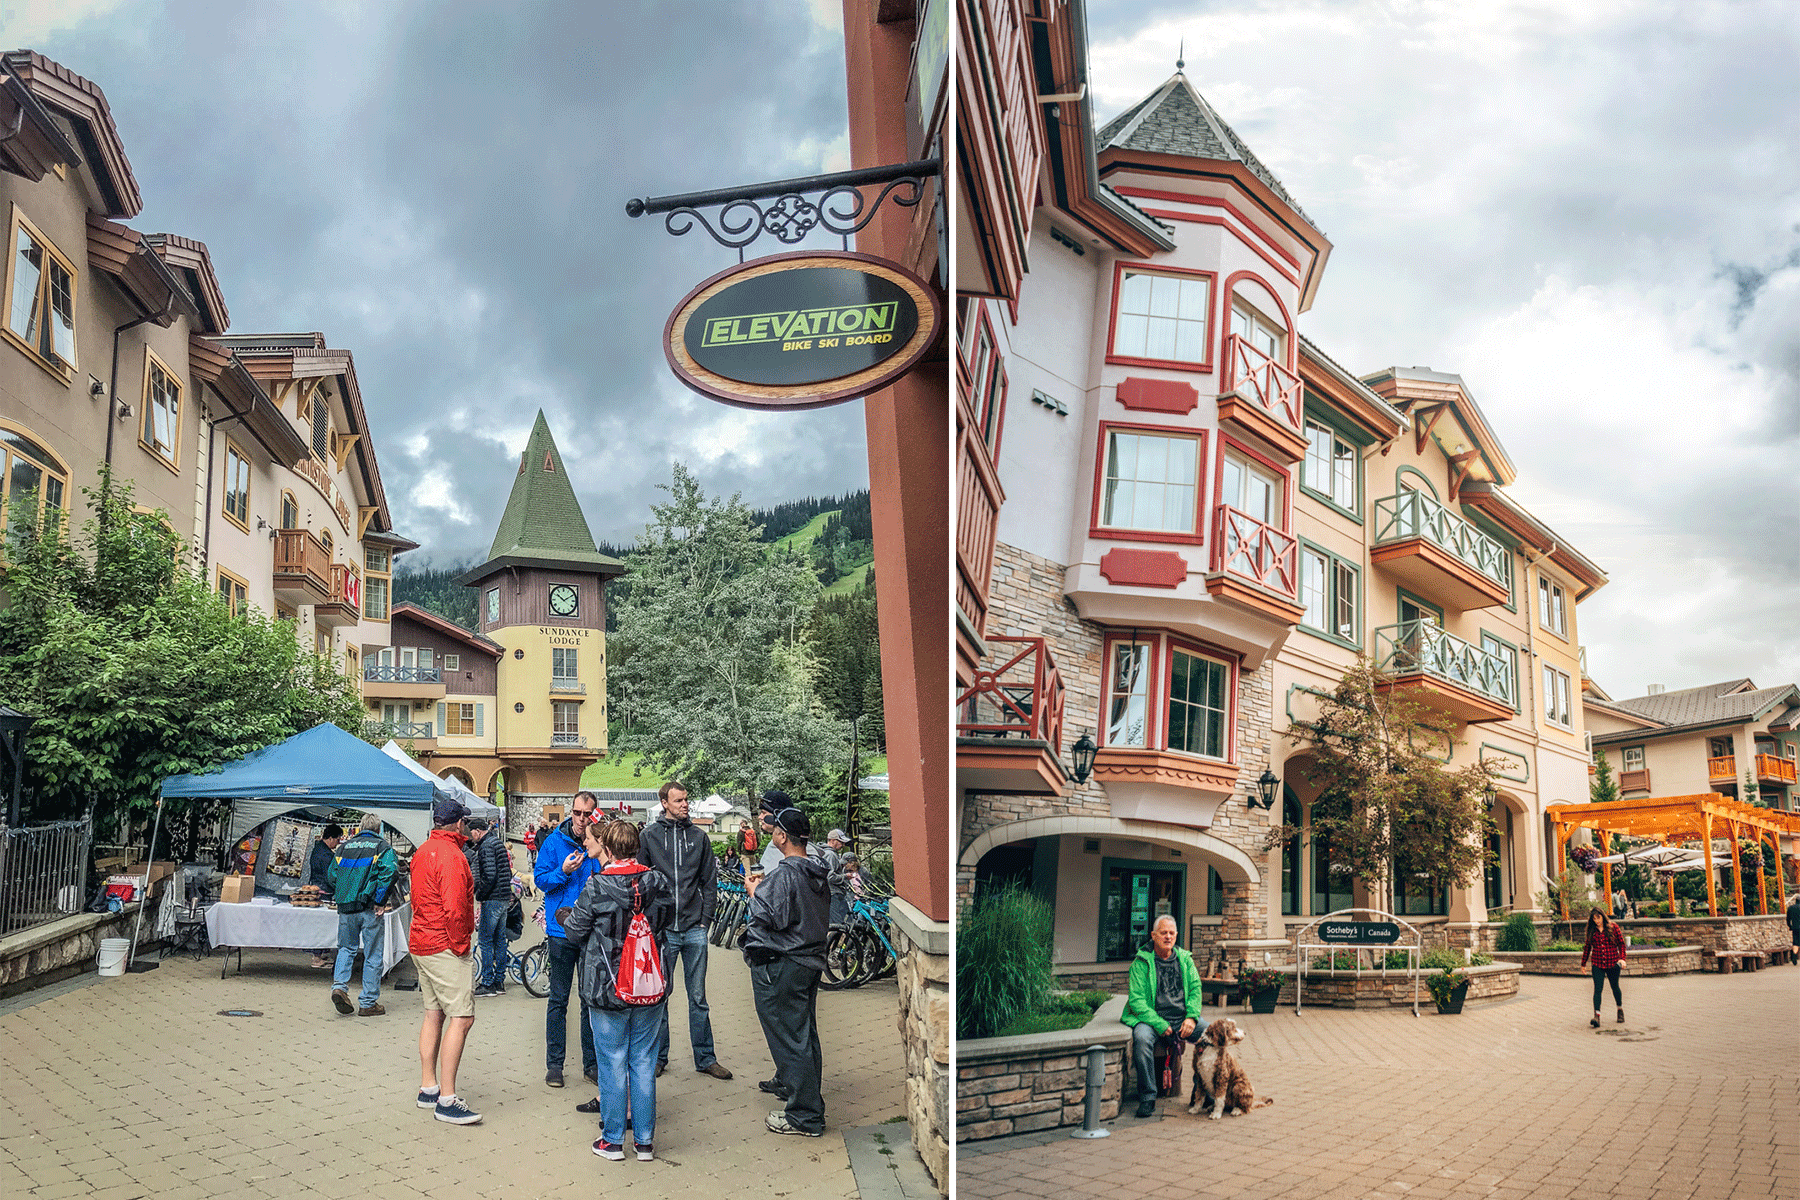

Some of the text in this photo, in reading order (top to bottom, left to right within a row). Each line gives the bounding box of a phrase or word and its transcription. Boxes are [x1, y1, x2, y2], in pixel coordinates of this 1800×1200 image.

[709, 305, 889, 343] ELEVATION
[782, 333, 893, 352] BIKE SKI BOARD
[539, 627, 589, 637] SUNDANCE
[549, 637, 581, 645] LODGE
[1326, 926, 1358, 936] Sotheby's
